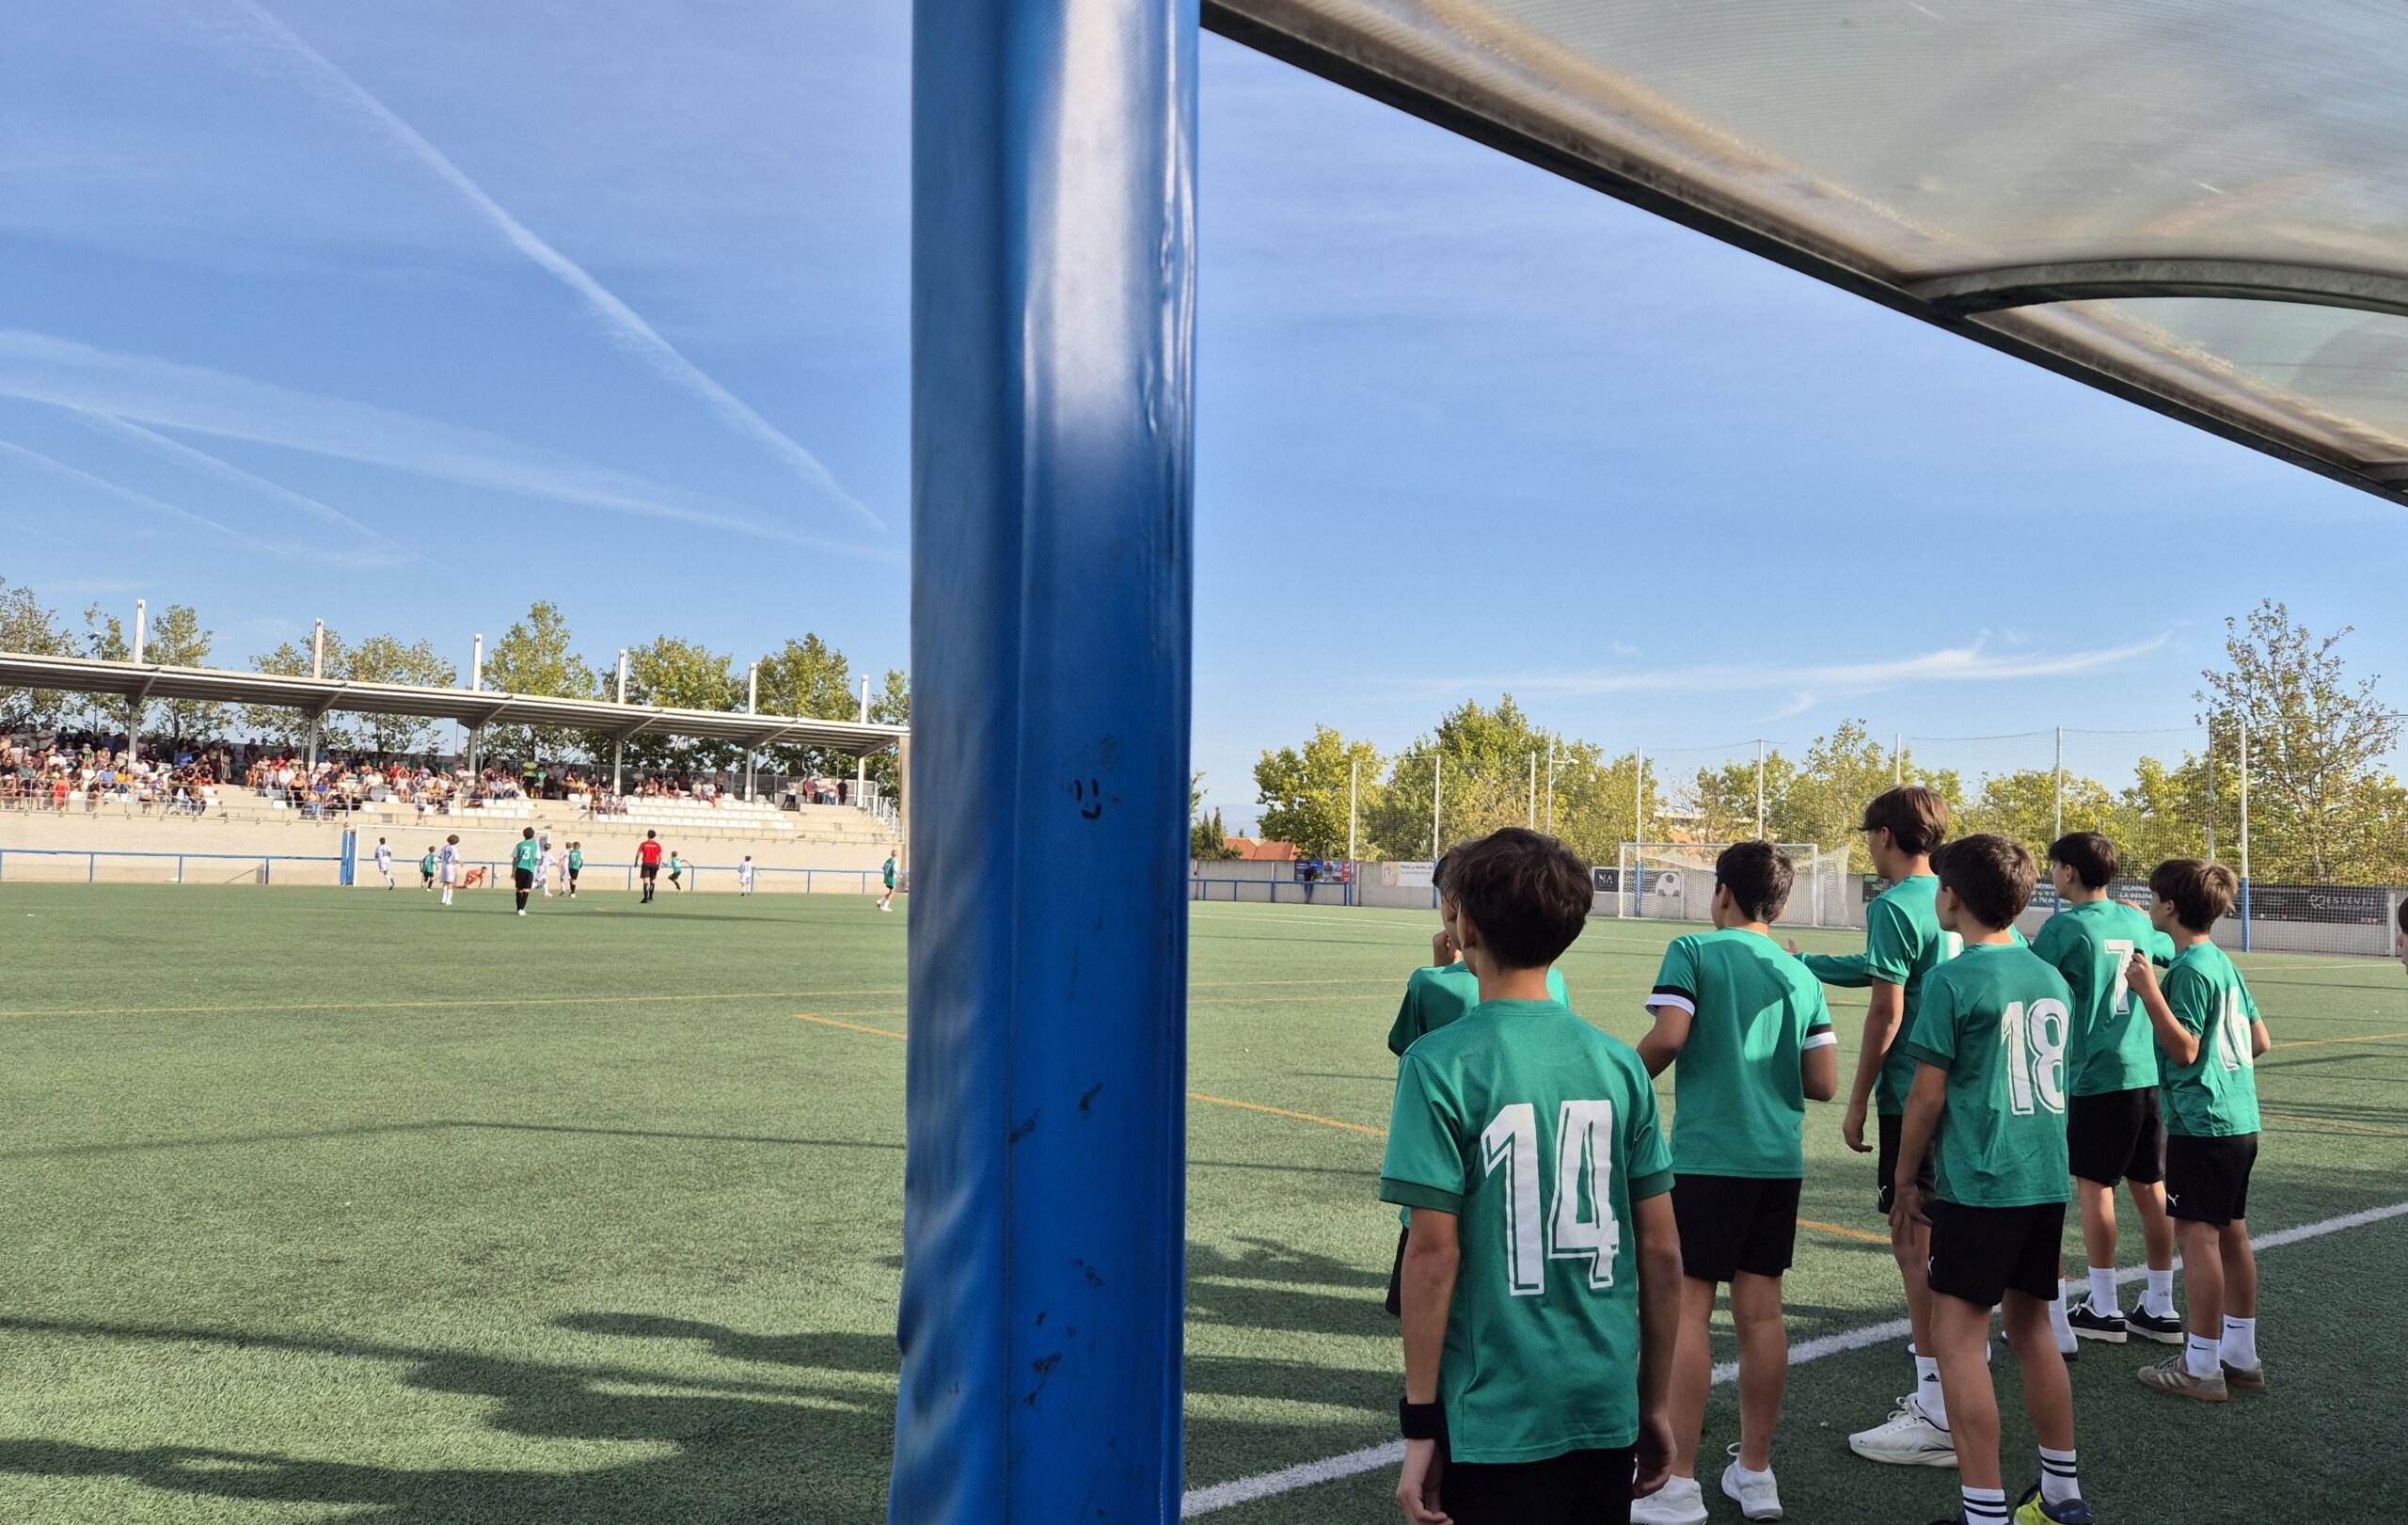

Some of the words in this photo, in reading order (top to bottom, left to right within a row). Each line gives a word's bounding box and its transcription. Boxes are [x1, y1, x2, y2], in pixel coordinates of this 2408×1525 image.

[522, 846, 531, 860] 3
[2104, 939, 2134, 1014] 7
[2001, 998, 2069, 1115] 18
[2217, 986, 2253, 1072] 16
[1481, 1100, 1619, 1295] 14
